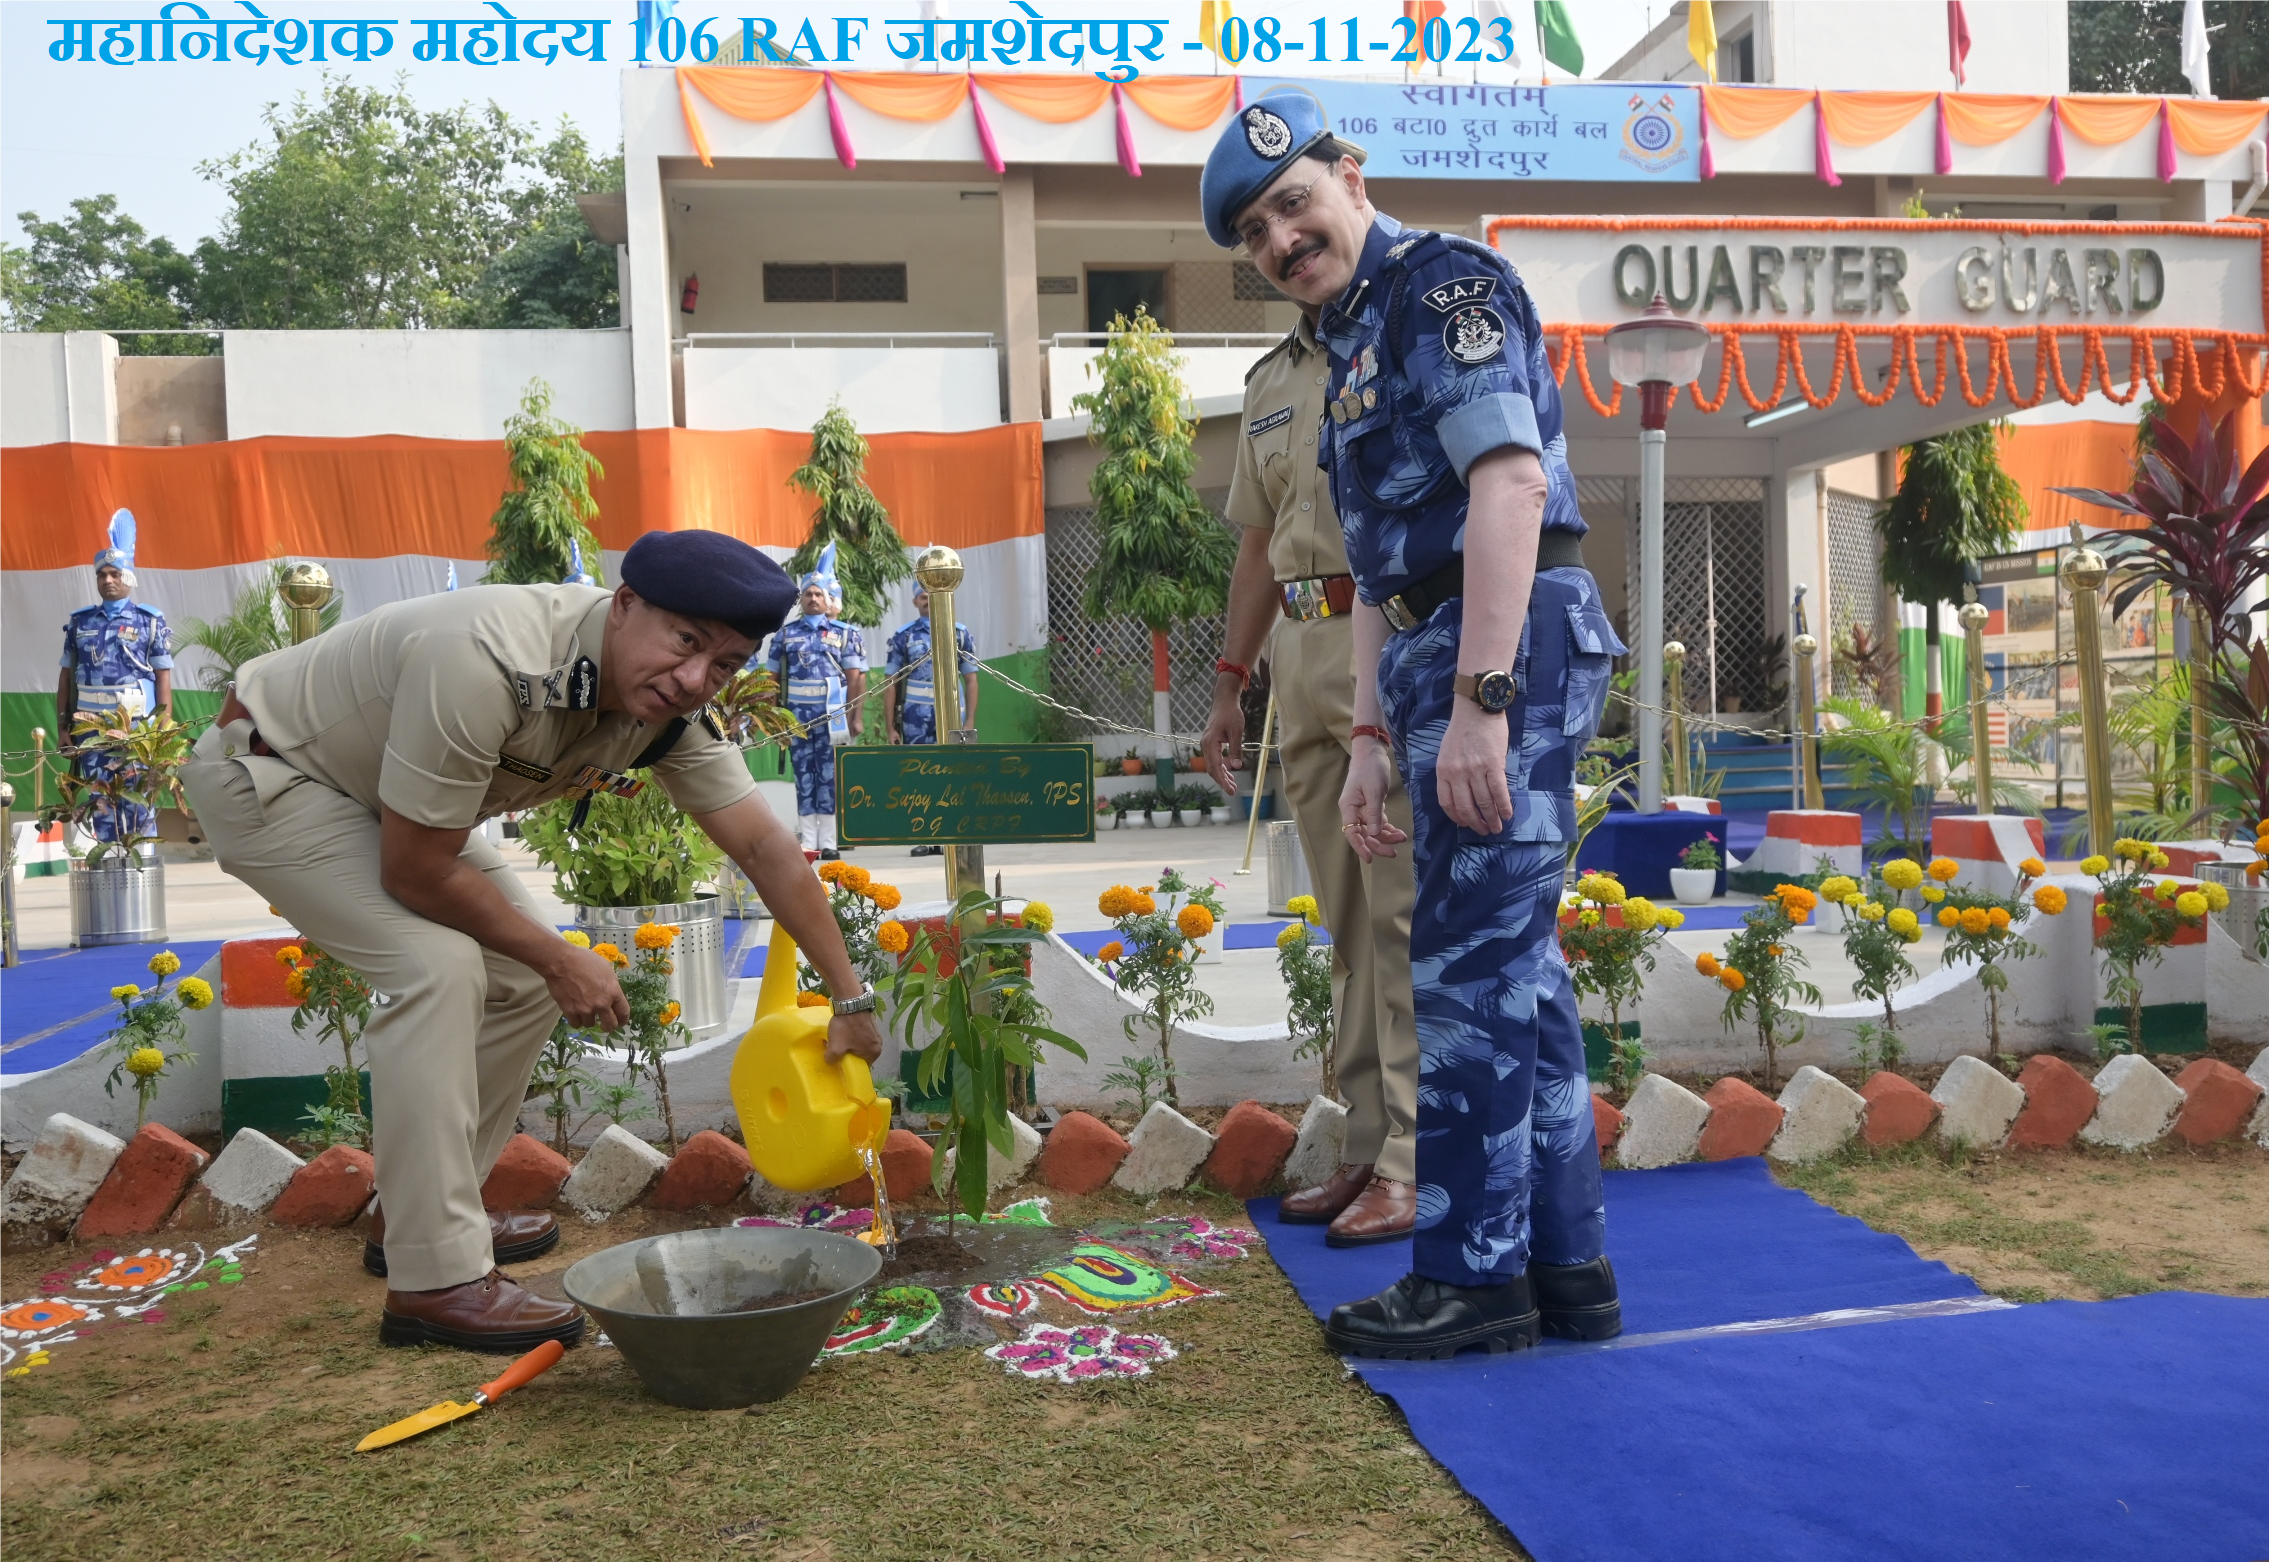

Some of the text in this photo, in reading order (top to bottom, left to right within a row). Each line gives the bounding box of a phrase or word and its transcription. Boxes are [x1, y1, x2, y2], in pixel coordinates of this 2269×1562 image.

[1399, 84, 1550, 116] स्वागतम्
[1339, 117, 1377, 134] 106
[1461, 119, 1499, 143] द्रुत
[1511, 114, 1559, 138] कार्य
[1573, 121, 1609, 139] बल
[1400, 143, 1551, 177] जमशेदपुर
[1614, 244, 2165, 314] QUARTER GUARD
[899, 756, 1032, 779] Pland By
[849, 785, 876, 809] Dr.
[885, 786, 932, 815] Sujoy
[936, 783, 967, 807] Lal
[1043, 780, 1083, 806] IPS
